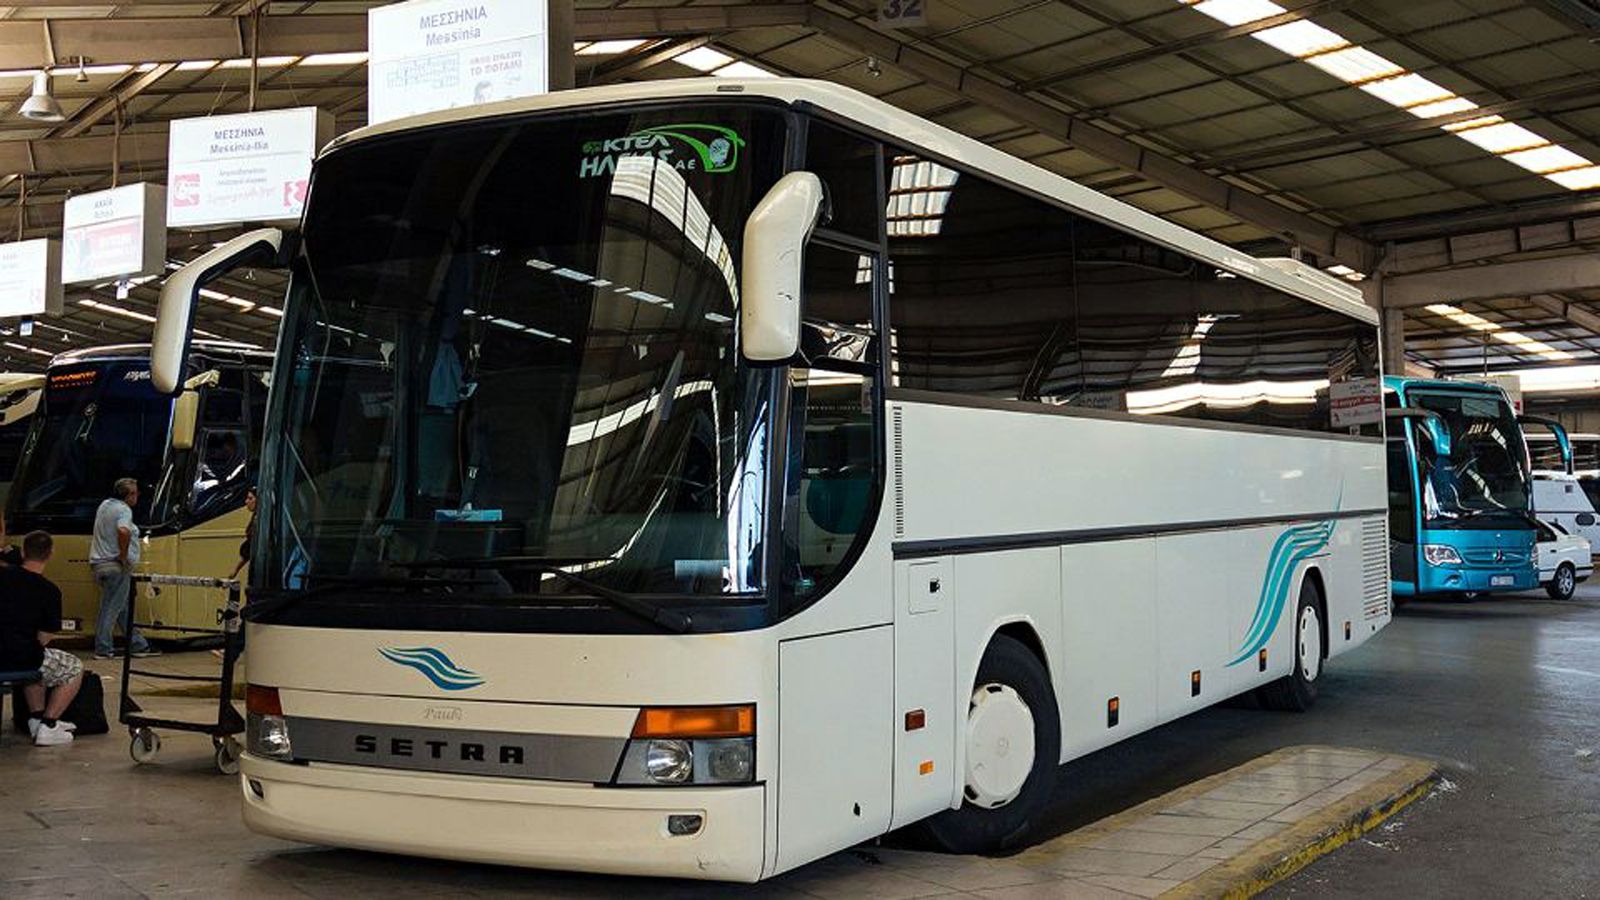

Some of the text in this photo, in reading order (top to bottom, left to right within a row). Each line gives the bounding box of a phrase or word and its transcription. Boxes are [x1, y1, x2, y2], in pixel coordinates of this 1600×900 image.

[419, 5, 488, 30] ΜΕΣΣΗΝΙΑ
[425, 27, 481, 47] Messinia
[214, 126, 265, 140] ΜΕΣΣΗΝΙΑ
[602, 134, 670, 153] ΚΤΕΛ
[354, 734, 525, 765] SETRA
